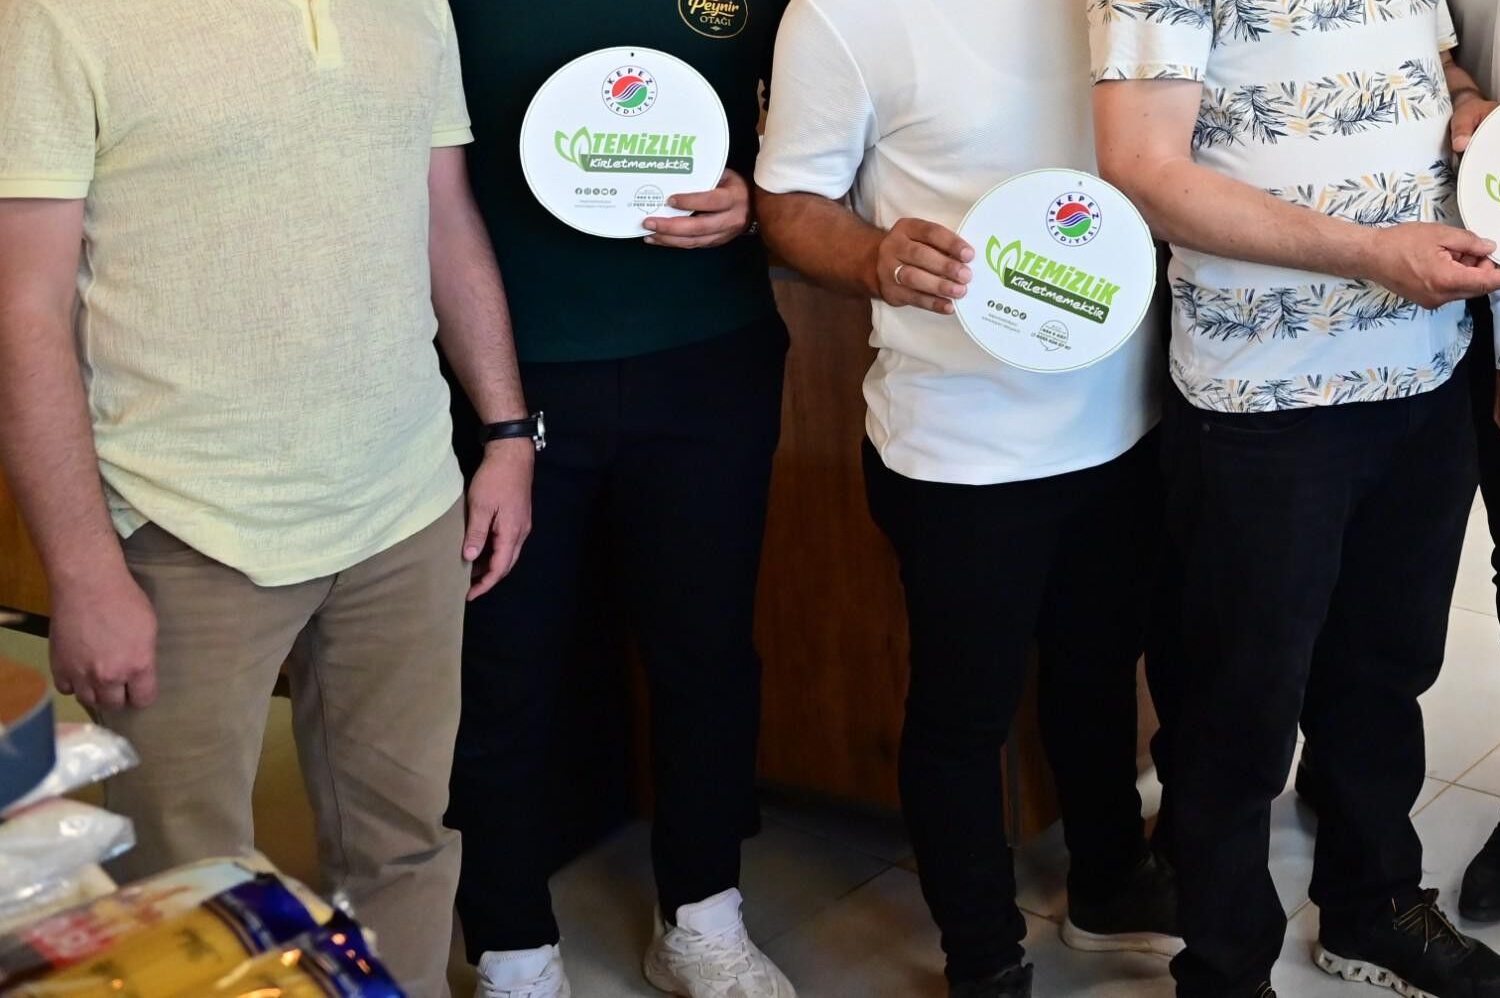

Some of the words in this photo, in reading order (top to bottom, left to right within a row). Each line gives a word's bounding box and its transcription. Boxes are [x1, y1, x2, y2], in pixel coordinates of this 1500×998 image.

[700, 15, 731, 27] OTAĞI
[607, 68, 653, 85] KEPEZ
[1056, 194, 1099, 220] KEPEZ
